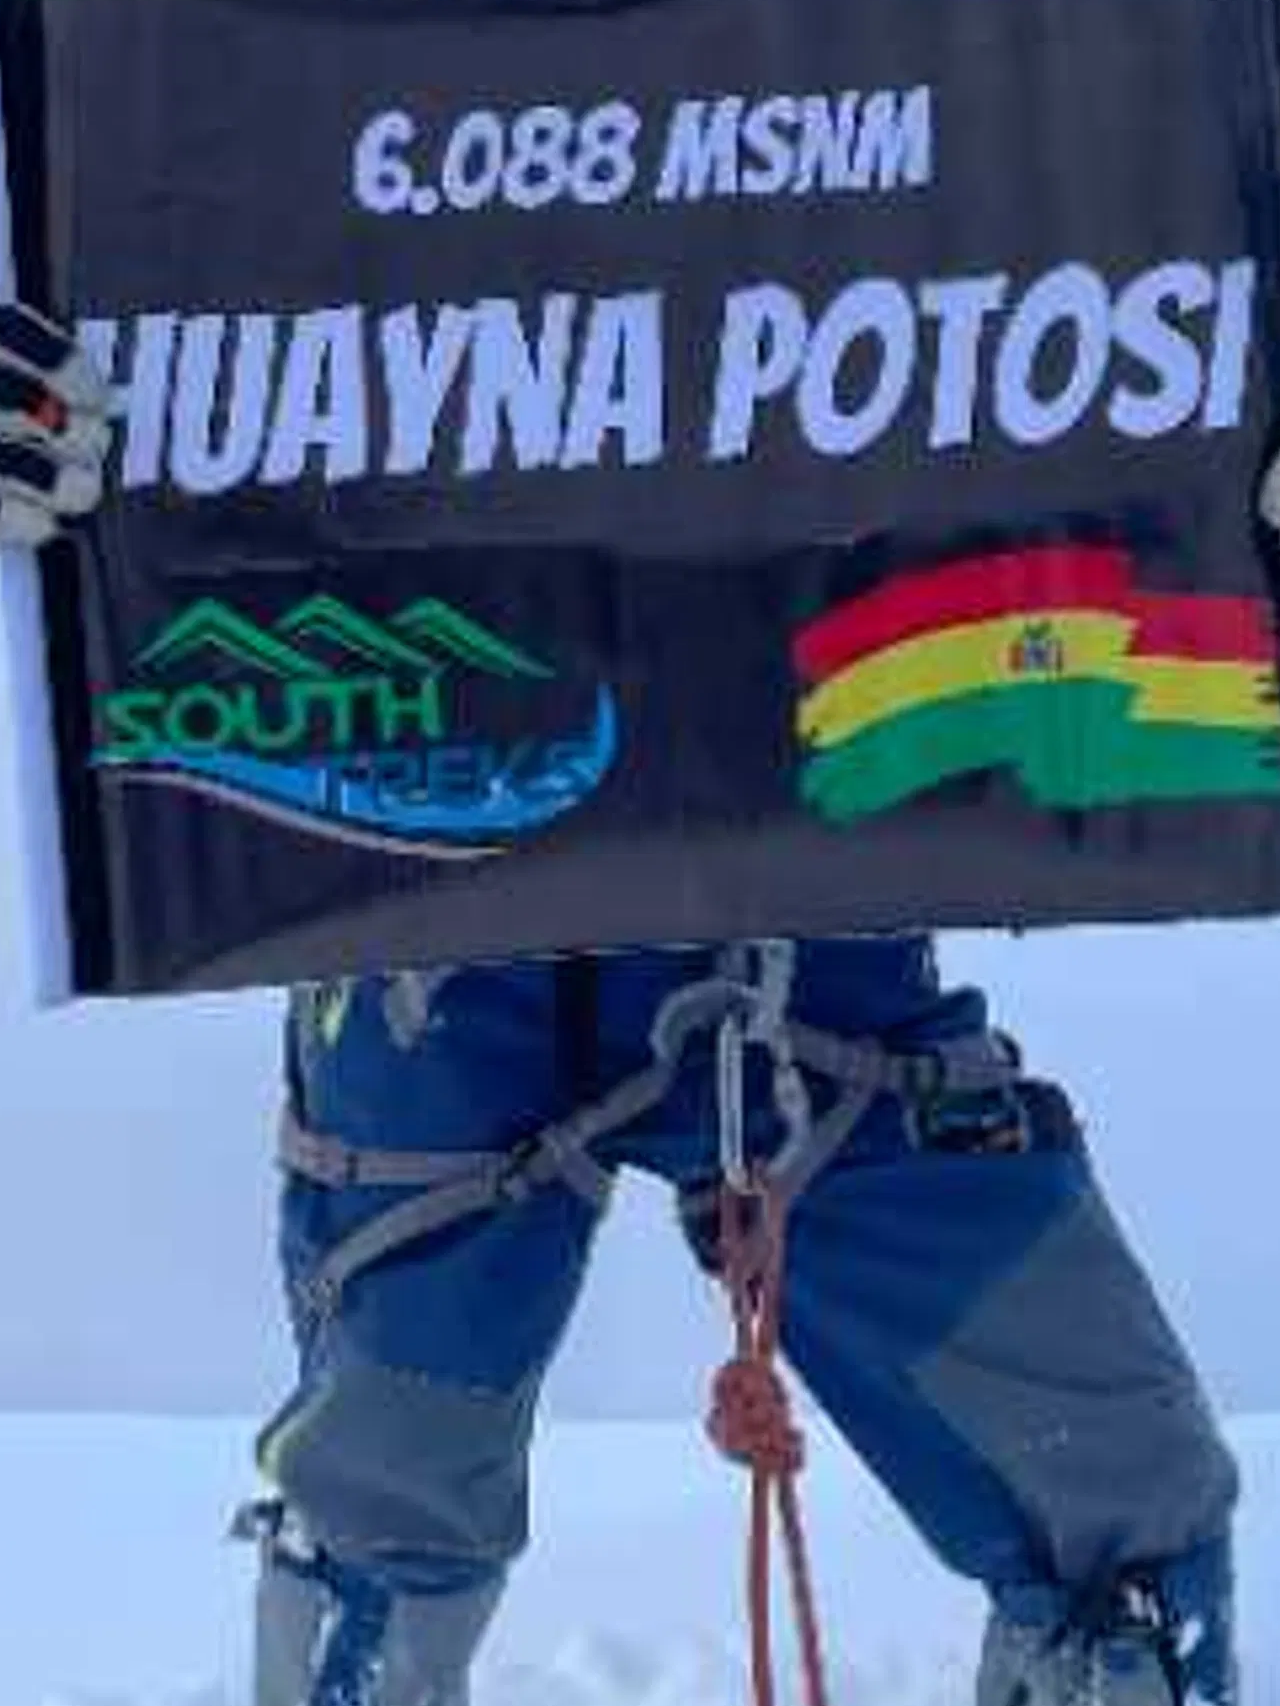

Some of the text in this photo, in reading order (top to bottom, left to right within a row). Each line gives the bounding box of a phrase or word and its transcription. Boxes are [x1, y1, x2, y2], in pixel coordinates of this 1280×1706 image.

[353, 85, 931, 214] 6.088 MSNM
[79, 257, 1256, 493] HUAYNA POTOSI
[100, 676, 446, 759] SOUTH
